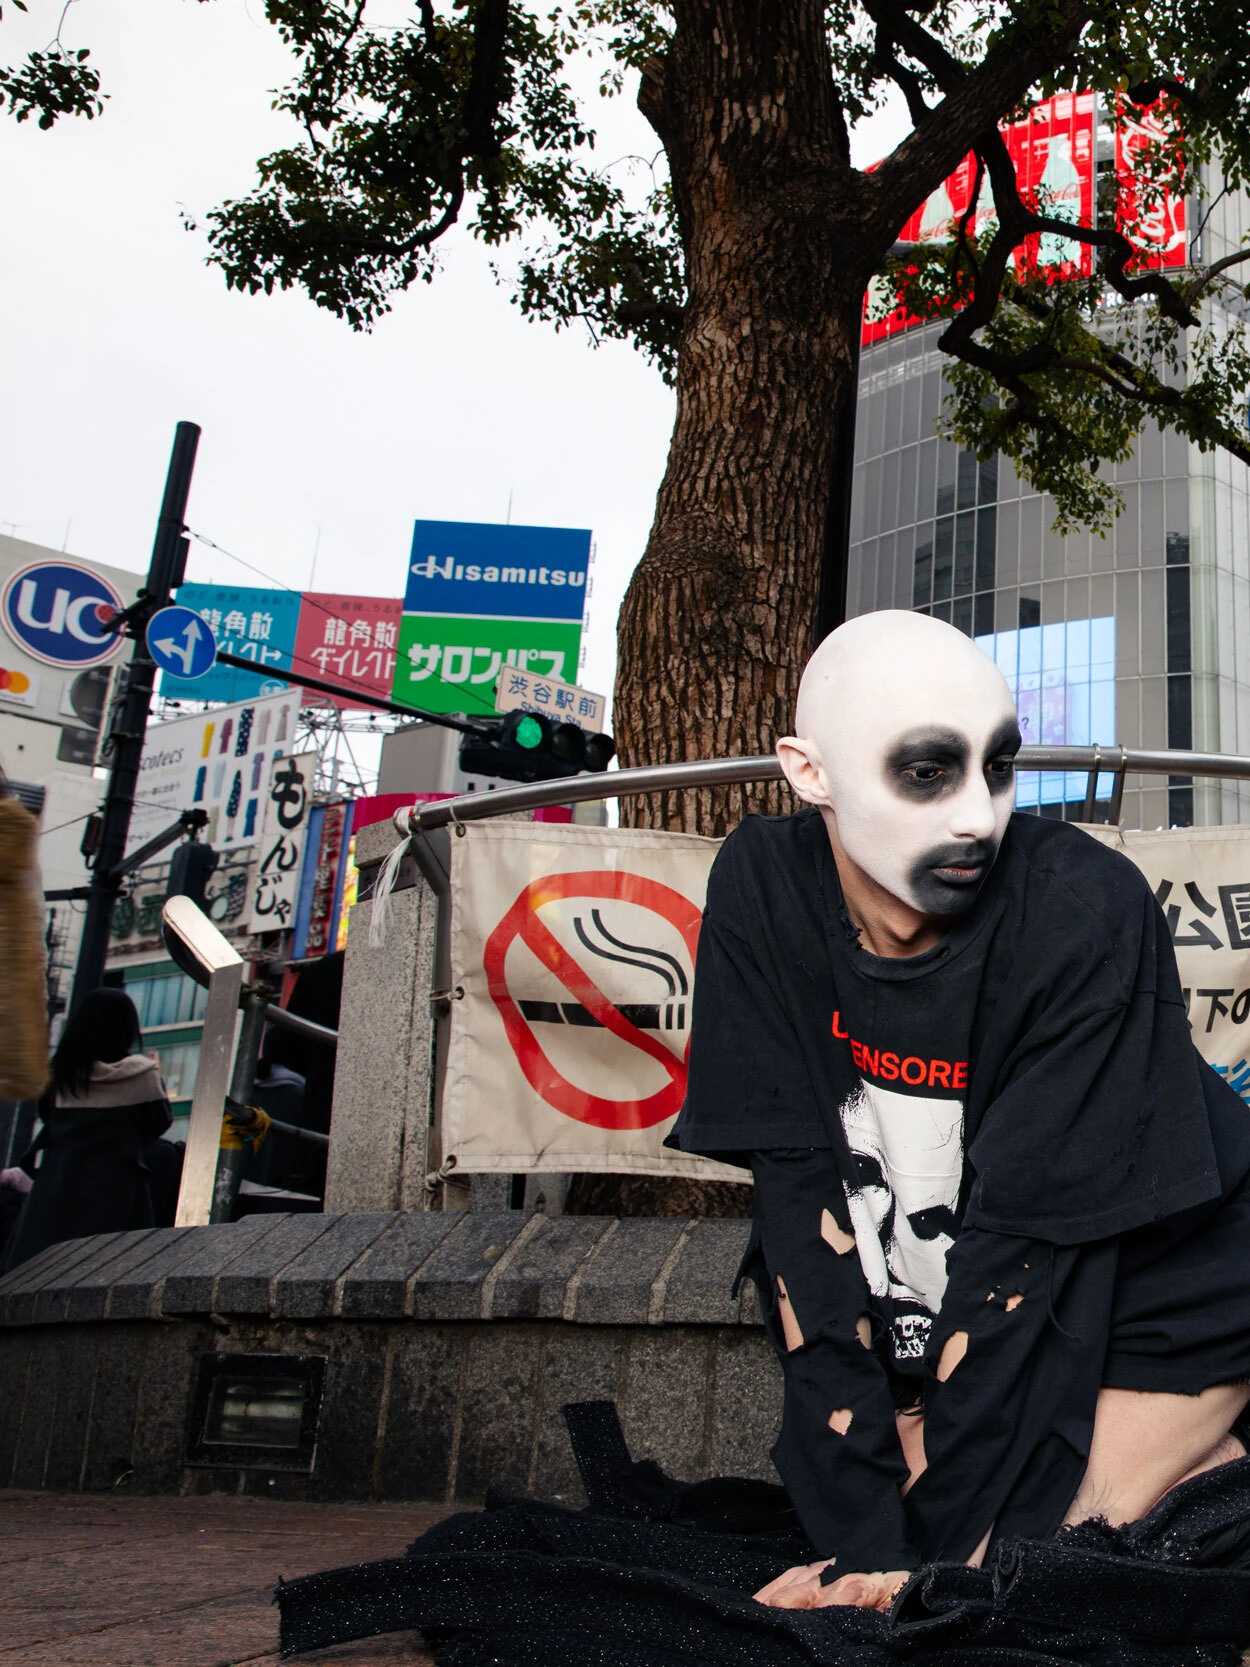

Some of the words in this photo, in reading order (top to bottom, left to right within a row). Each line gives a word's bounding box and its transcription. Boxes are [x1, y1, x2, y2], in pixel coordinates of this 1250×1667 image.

[411, 555, 585, 586] Hisamitsu
[17, 579, 120, 644] UC
[323, 617, 397, 650] 龍角散
[408, 643, 566, 685] サロンパス
[508, 674, 597, 719] 渋谷駅前
[255, 758, 308, 925] もんじゃ
